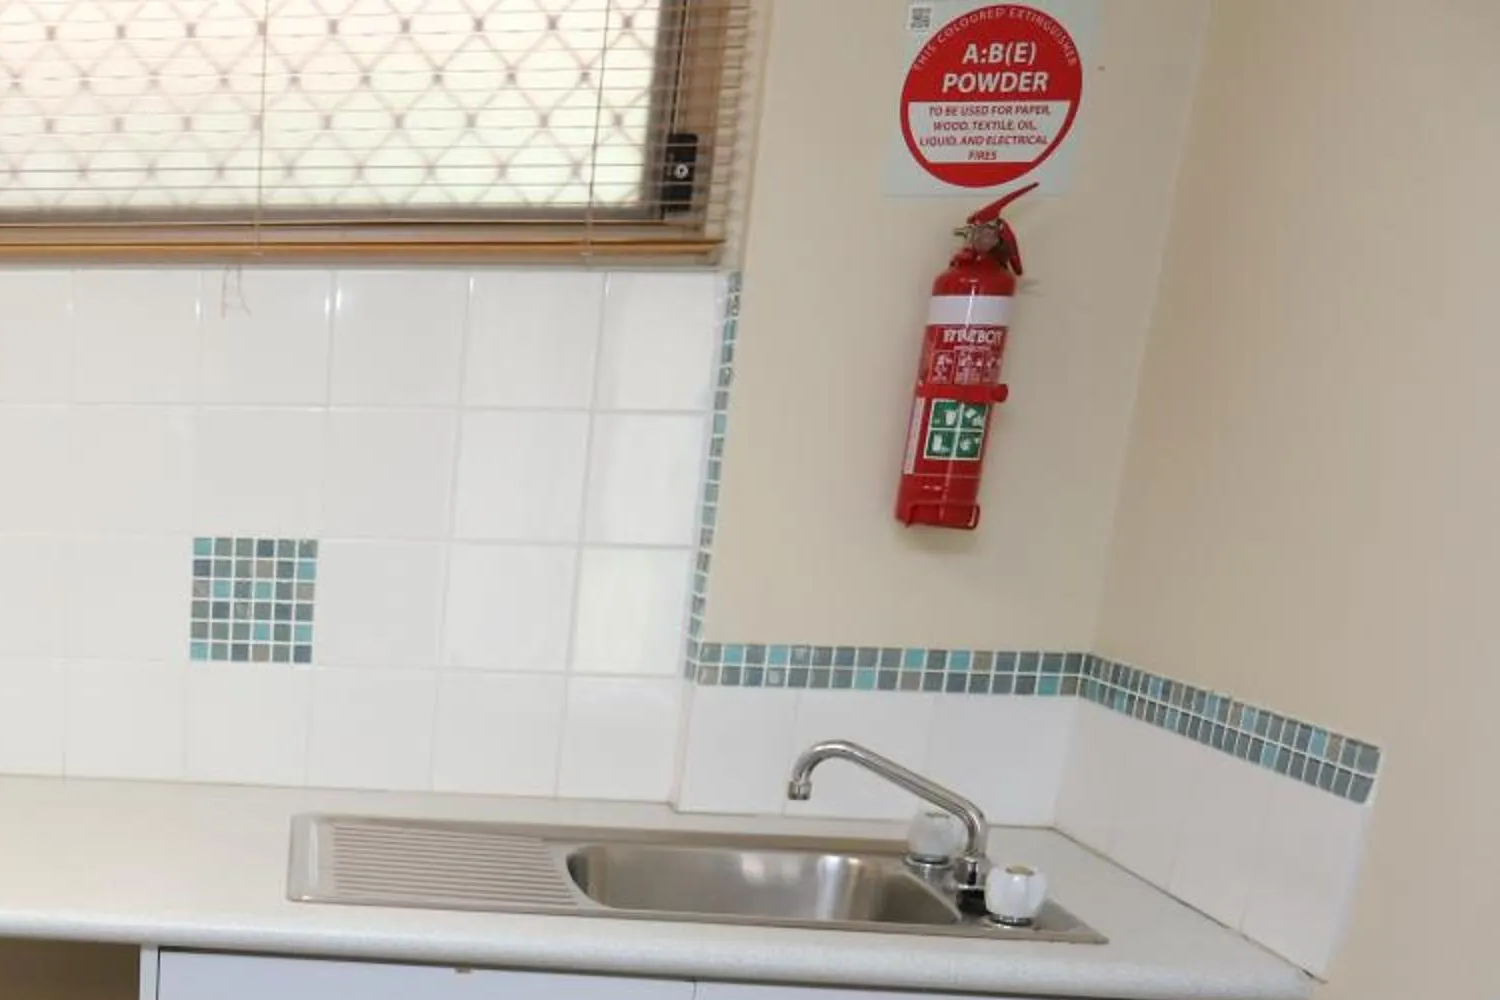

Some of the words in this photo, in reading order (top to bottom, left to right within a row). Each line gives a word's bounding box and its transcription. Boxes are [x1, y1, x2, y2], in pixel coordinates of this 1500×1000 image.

[962, 41, 1037, 66] A:B(E)
[942, 71, 1049, 93] POWDER
[929, 106, 942, 116] TO
[945, 106, 958, 116] BE
[961, 105, 989, 116] USED
[991, 105, 1013, 115] FOR
[960, 135, 985, 145] AND
[986, 135, 1048, 145] ELECTRICAL
[968, 150, 997, 160] FIRES
